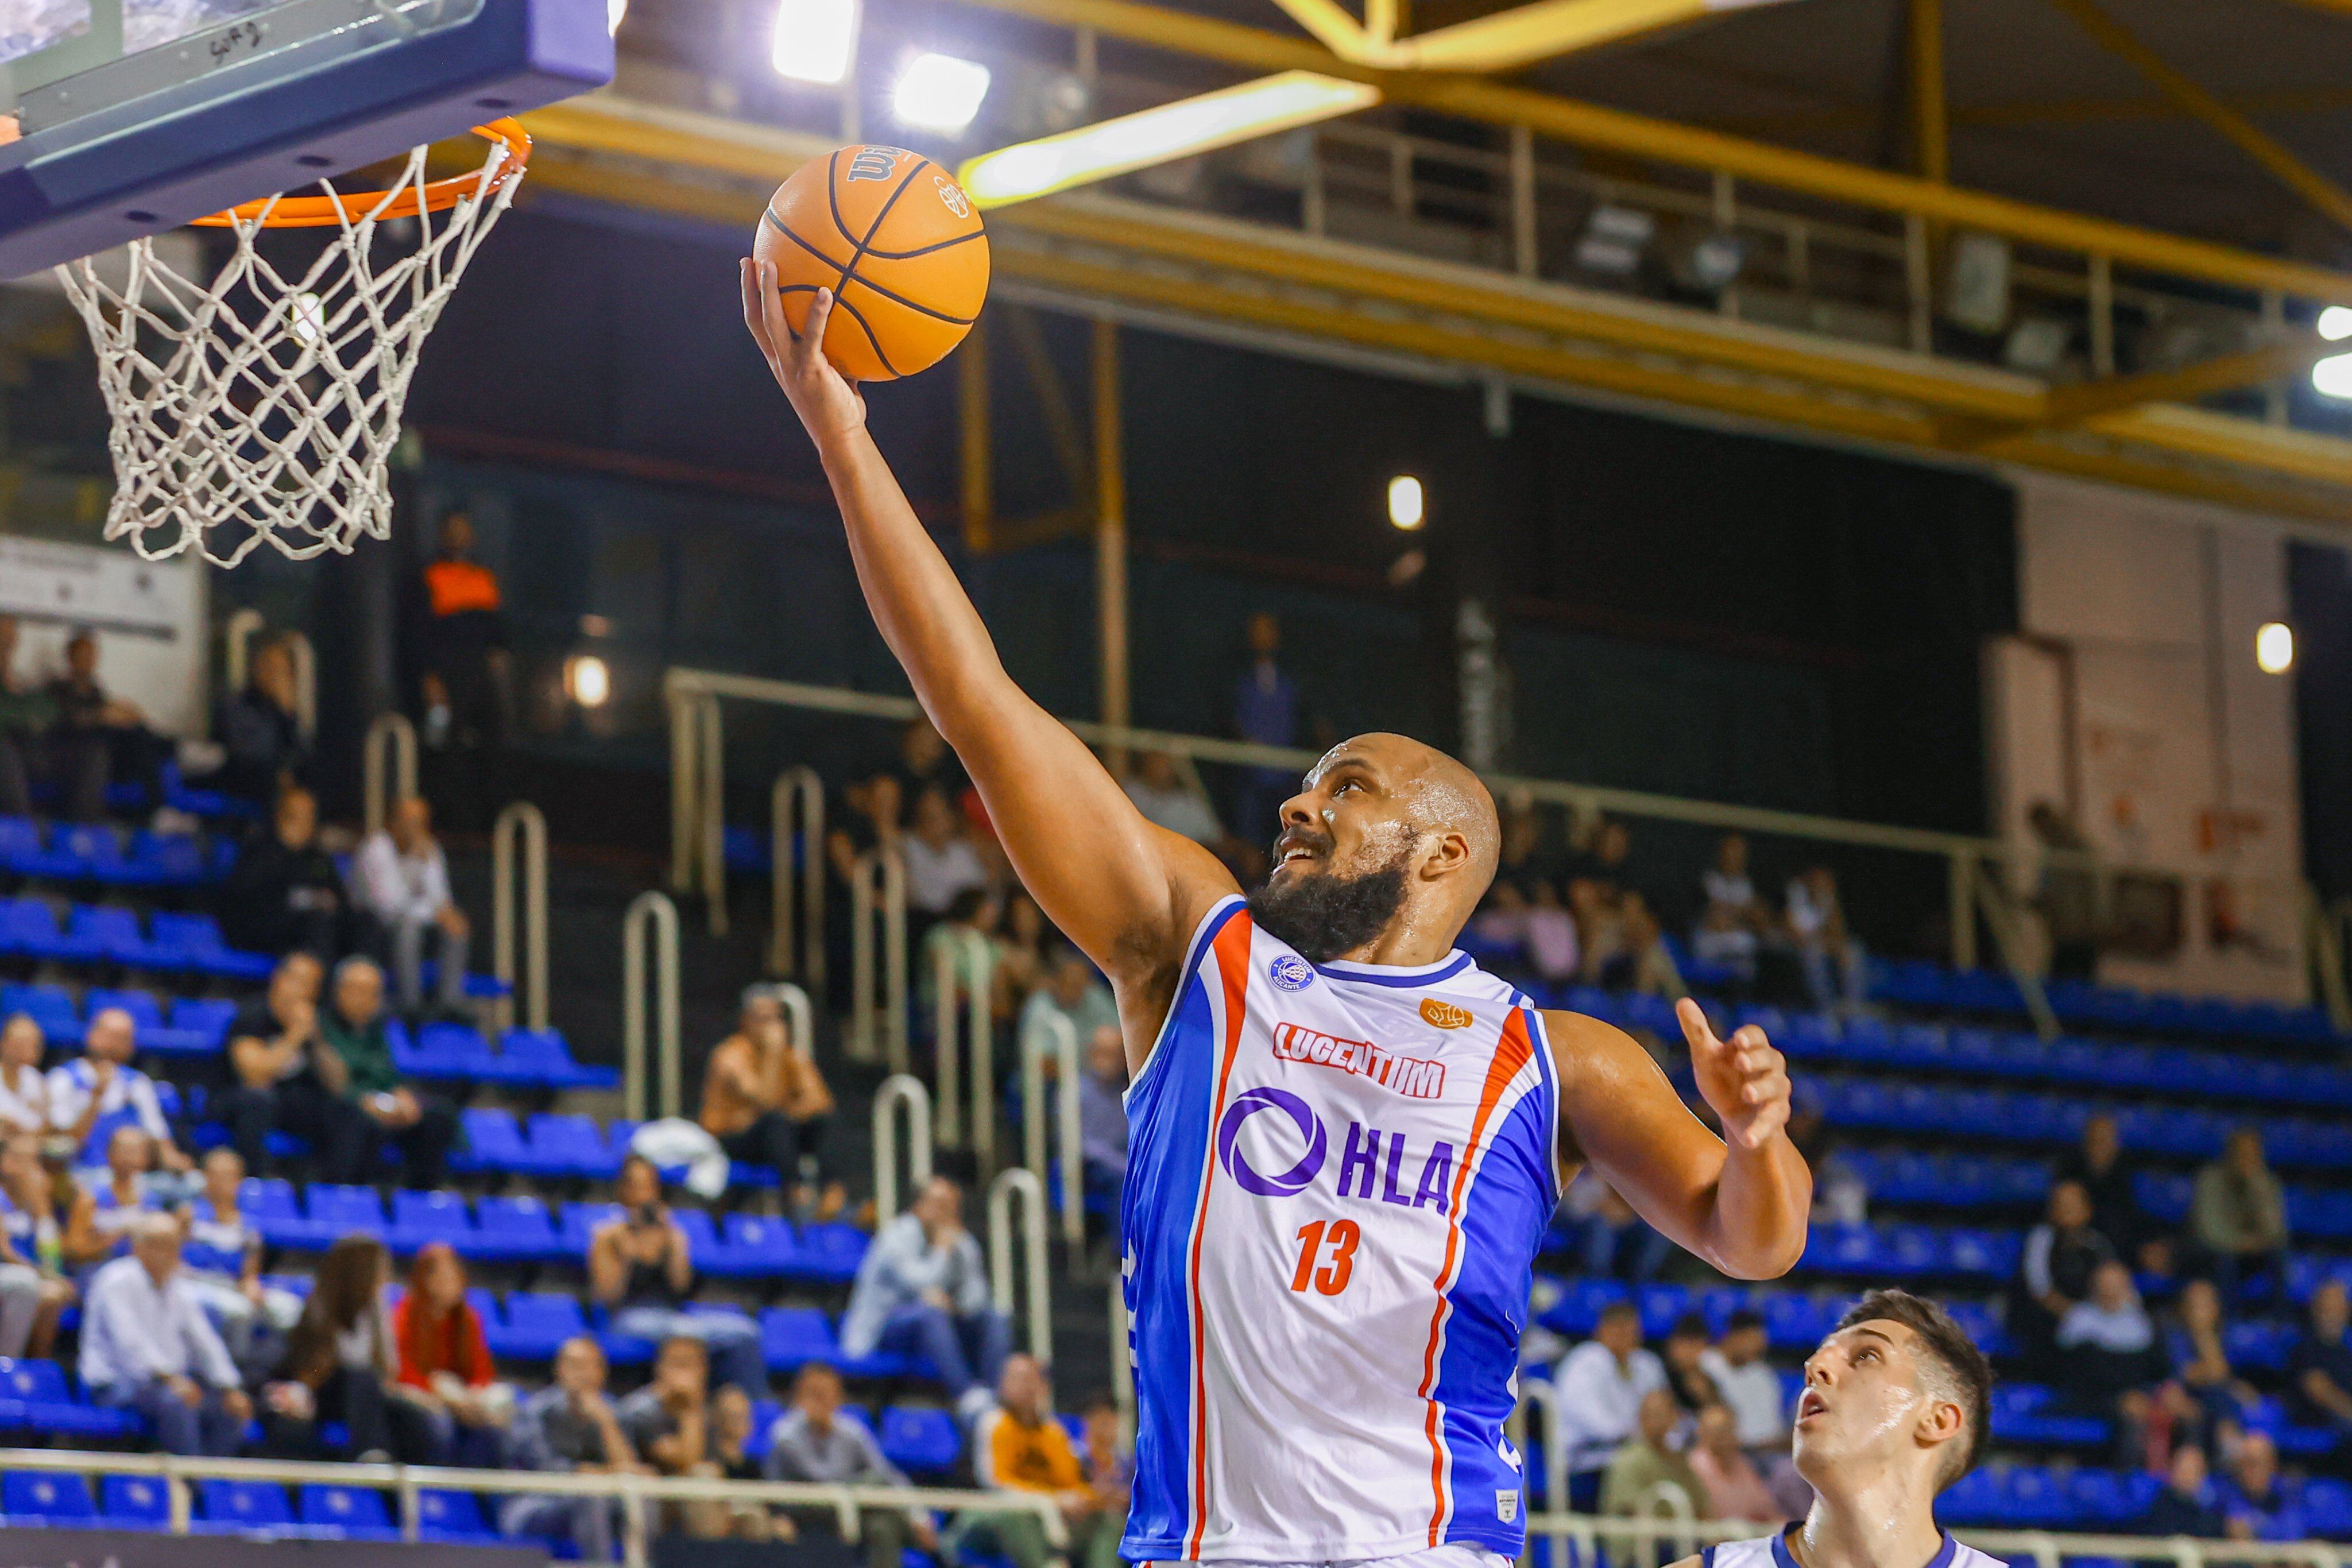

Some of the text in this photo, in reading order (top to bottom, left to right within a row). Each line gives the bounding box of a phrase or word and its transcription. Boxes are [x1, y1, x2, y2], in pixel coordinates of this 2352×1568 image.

[1272, 976, 1301, 989] ALICANTE
[1282, 957, 1312, 973] LUCENTUM
[1274, 1023, 1445, 1099] LUCENTUM
[1290, 1219, 1360, 1296] 13
